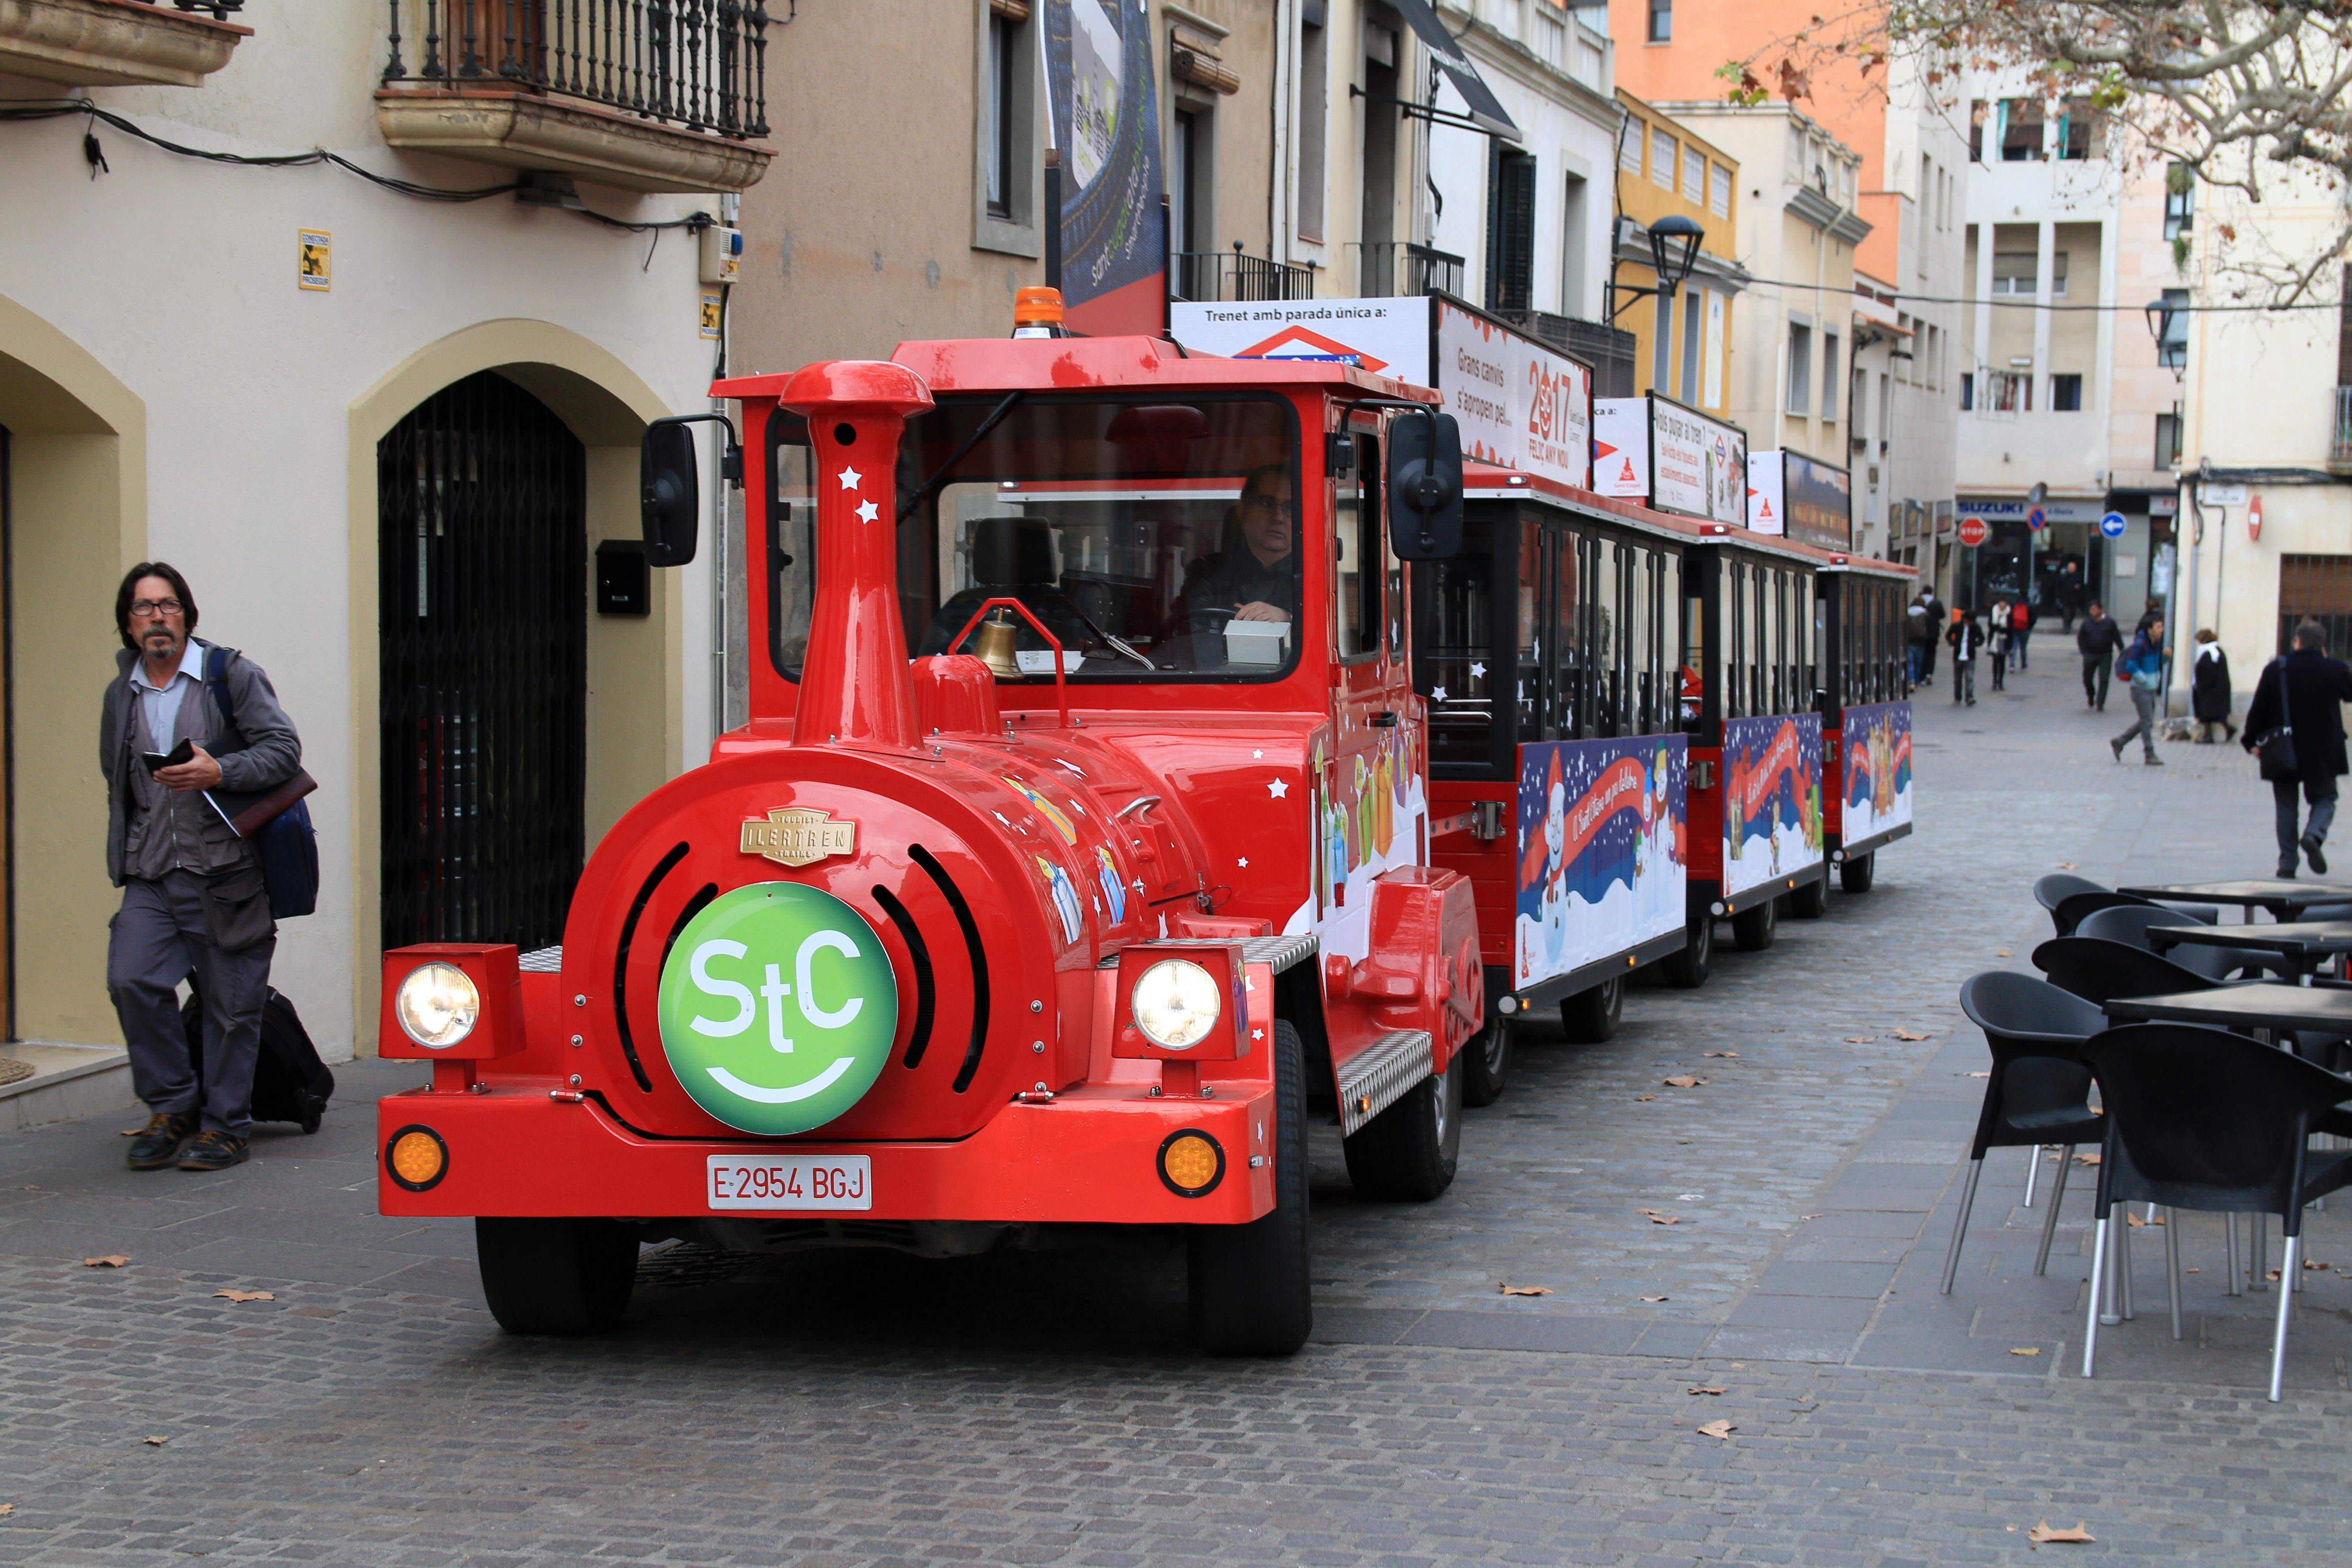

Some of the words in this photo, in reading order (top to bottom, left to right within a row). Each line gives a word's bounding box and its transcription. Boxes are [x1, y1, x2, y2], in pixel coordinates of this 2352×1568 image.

[302, 276, 329, 285] PROSEGUR
[1205, 310, 1248, 322] Trenet
[1253, 309, 1282, 320] amb
[1285, 307, 1332, 323] parada
[1335, 307, 1371, 318] única
[1374, 307, 1387, 318] a:
[1458, 346, 1480, 378] Grans
[1482, 361, 1504, 387] canvis
[1458, 385, 1494, 423] s'apropen
[1529, 360, 1571, 444] 2017
[1529, 437, 1544, 466] FELIÇ
[1545, 444, 1556, 466] ANY
[1958, 501, 2024, 514] SUZUKI
[780, 815, 817, 824] TOURIST
[747, 828, 845, 847] ILERTREN
[689, 929, 864, 1054] StC
[812, 1167, 864, 1198] BGJ
